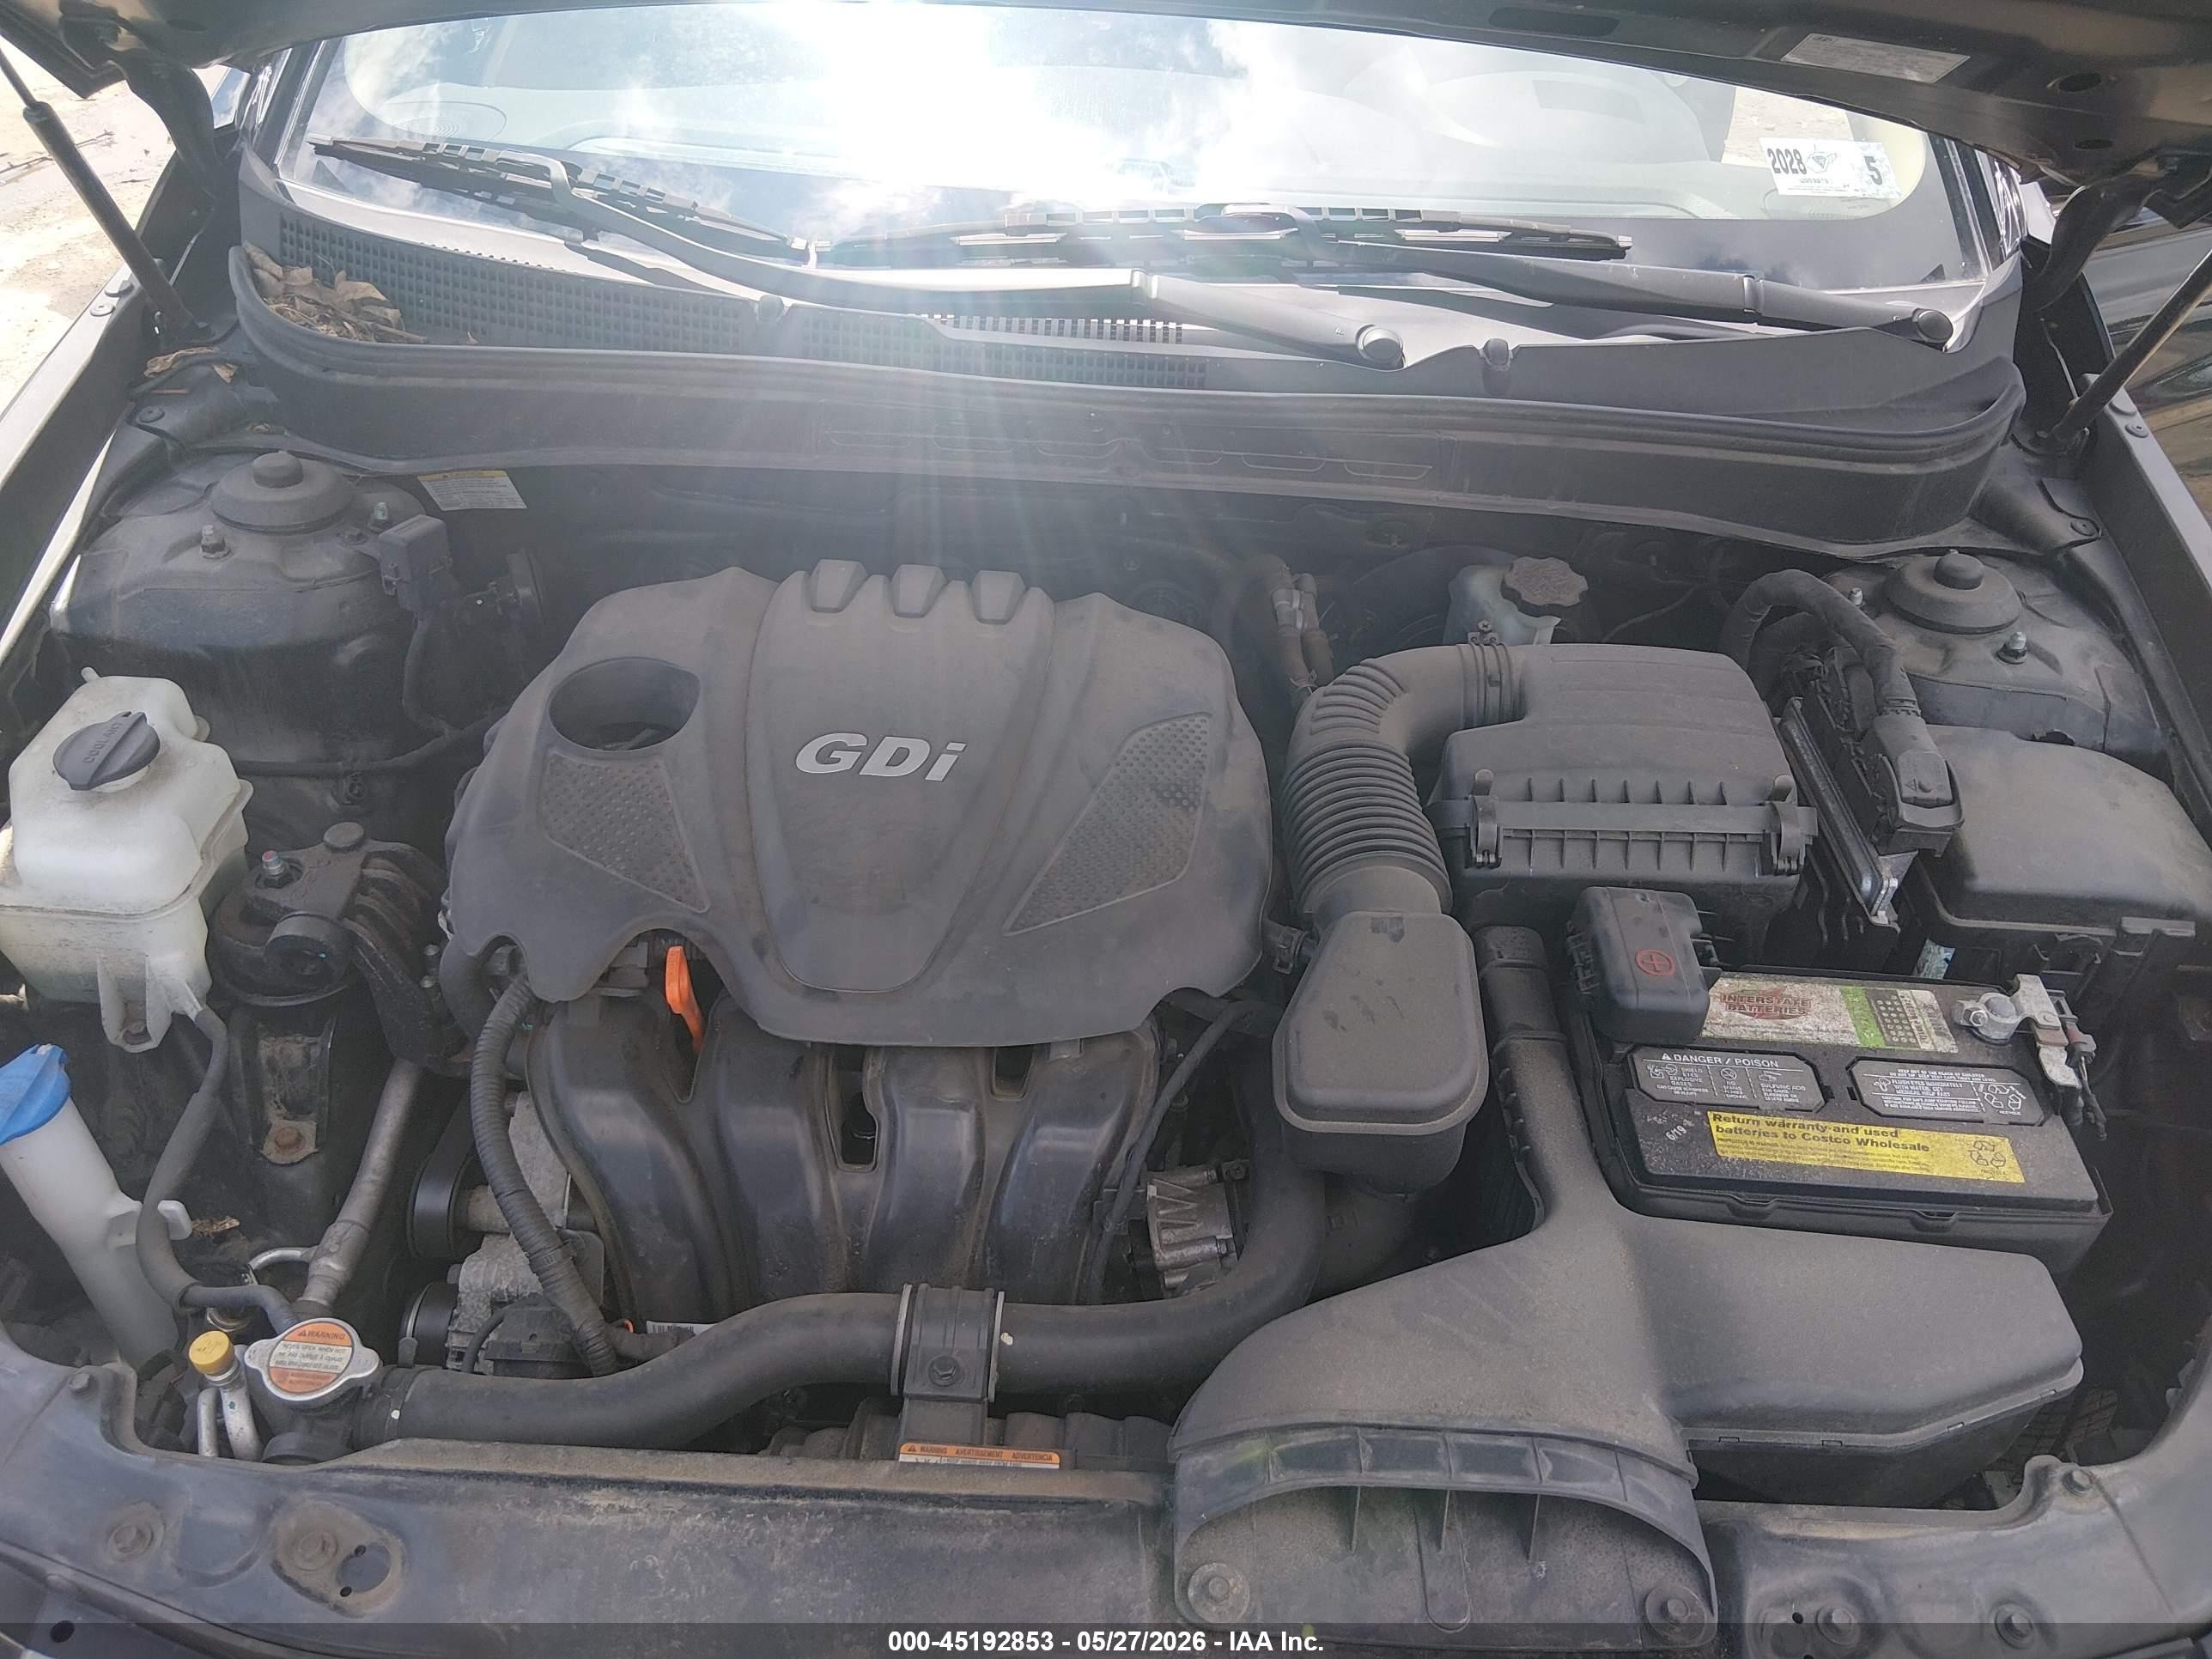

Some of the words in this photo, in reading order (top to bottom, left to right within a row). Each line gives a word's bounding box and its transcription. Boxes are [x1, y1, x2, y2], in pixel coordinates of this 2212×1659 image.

[1767, 149, 1807, 174] 2028
[1863, 155, 1883, 185] 5
[82, 722, 124, 763] COOLANT
[796, 732, 967, 781] GDi
[1719, 994, 1812, 1007] INTERSTATE
[1726, 1003, 1808, 1016] BATTERIES
[1674, 1054, 1722, 1064] DANGER
[1735, 1058, 1779, 1068] POISON
[1713, 1113, 1760, 1126] Return
[1765, 1115, 1827, 1132] warranty
[1832, 1125, 1860, 1135] and
[1864, 1127, 1899, 1139] used
[1716, 1125, 1778, 1139] batteries
[1784, 1129, 1796, 1140] to
[1802, 1131, 1851, 1145] Costco
[1856, 1137, 1930, 1152] Wholesale
[306, 1331, 345, 1340] WARNING
